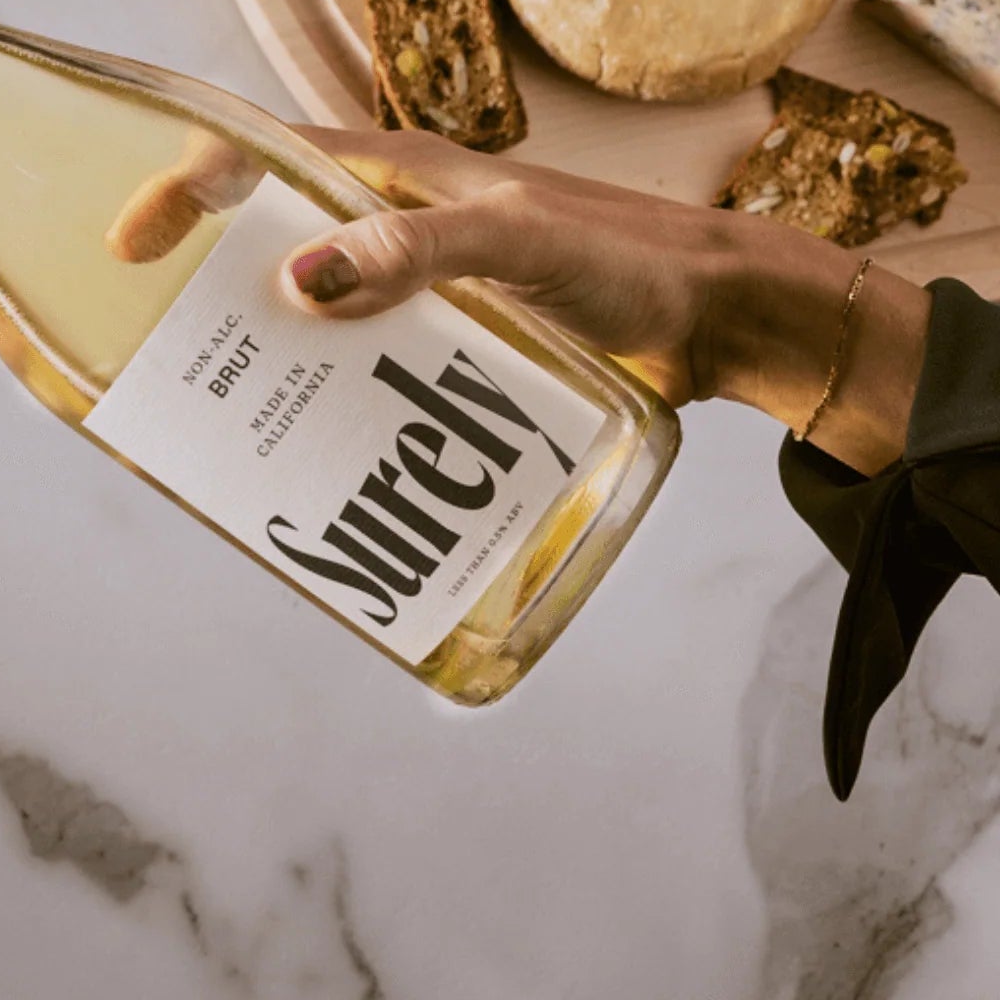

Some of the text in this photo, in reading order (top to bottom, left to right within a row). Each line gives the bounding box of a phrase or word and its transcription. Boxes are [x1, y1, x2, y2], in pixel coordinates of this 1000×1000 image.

[182, 314, 243, 385] NON-ALC.
[208, 334, 260, 398] BRUT
[250, 363, 306, 433] MADE IN
[256, 361, 335, 457] CALIFORNIA
[266, 349, 577, 627] Surely
[447, 574, 469, 597] LESS
[466, 547, 490, 574] THAN
[506, 501, 523, 523] ABV
